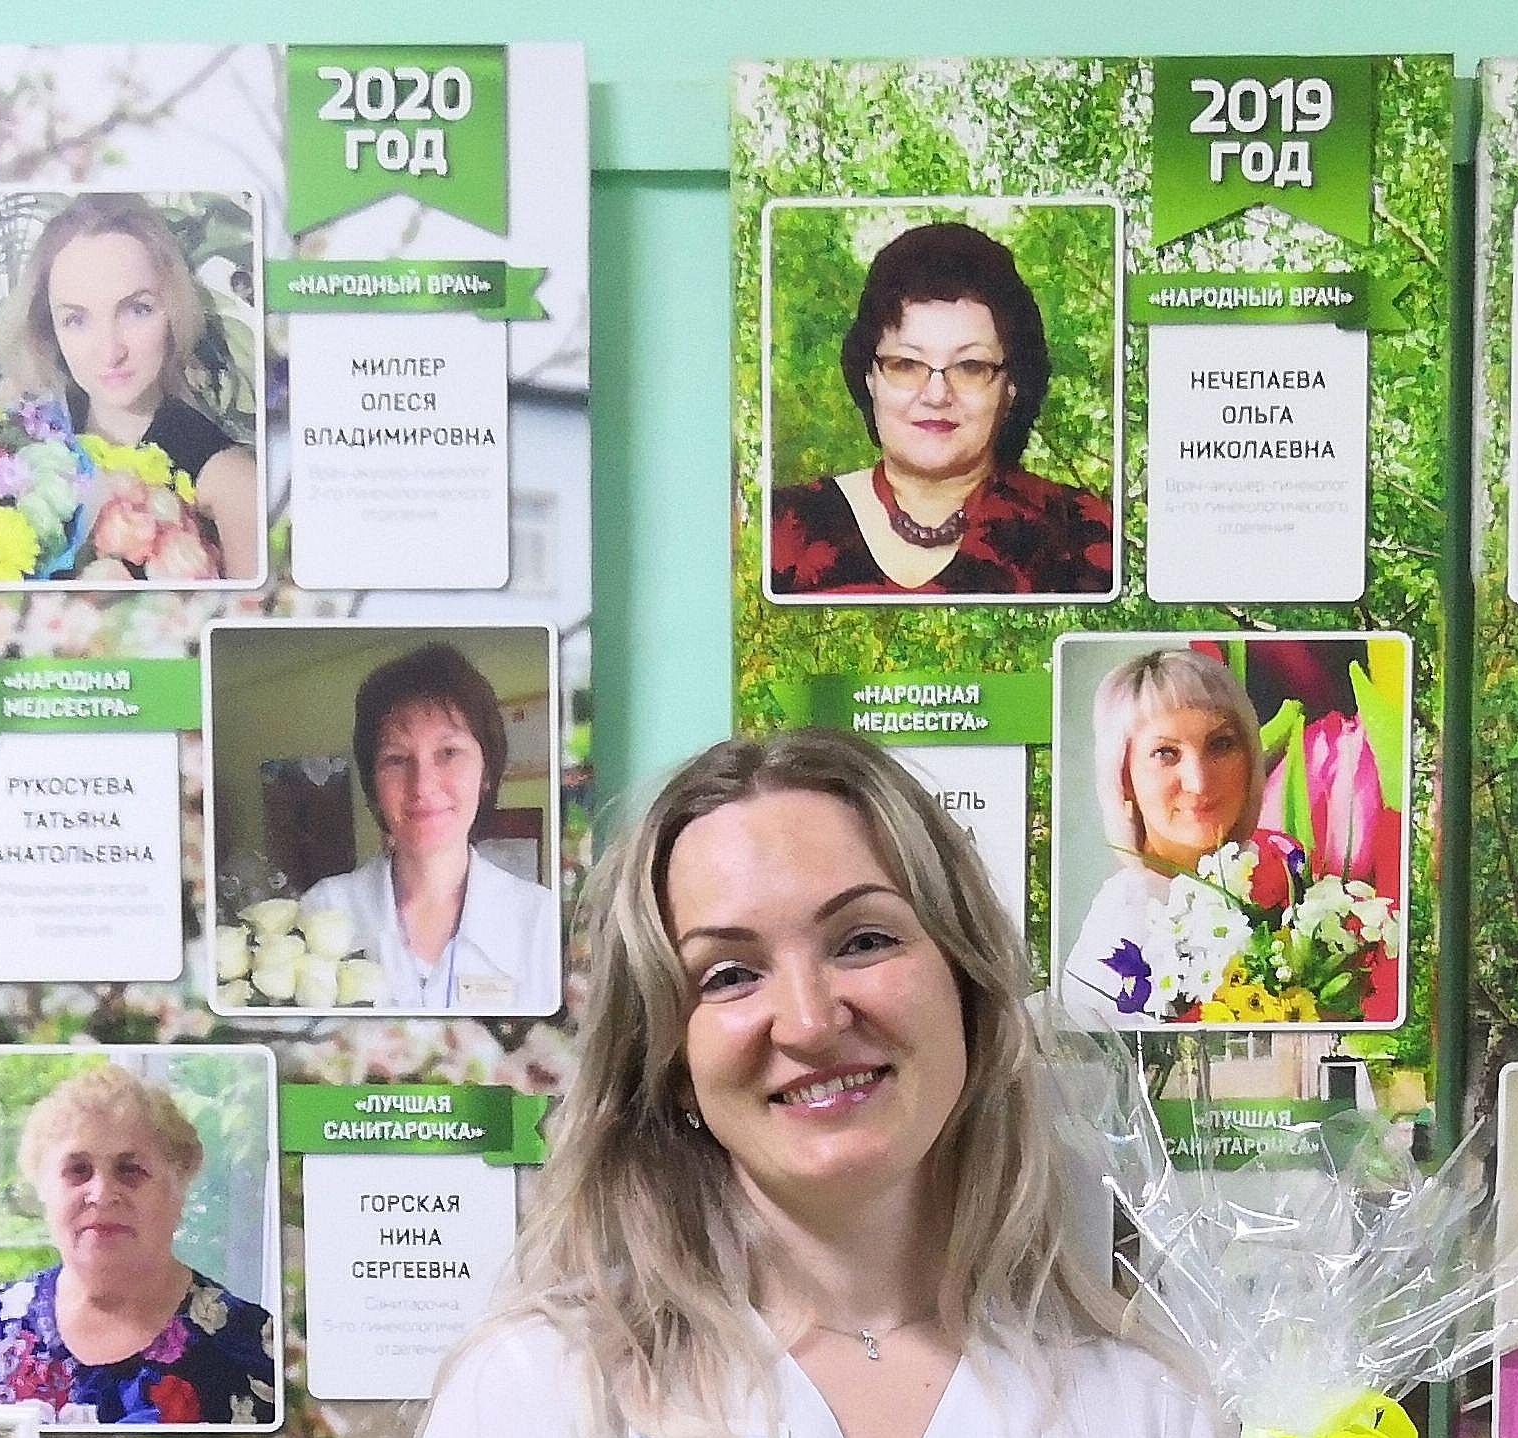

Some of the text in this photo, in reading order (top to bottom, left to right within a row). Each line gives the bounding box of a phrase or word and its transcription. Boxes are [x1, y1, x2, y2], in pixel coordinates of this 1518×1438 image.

[318, 66, 472, 121] 2020
[1190, 77, 1333, 135] 2019
[344, 127, 448, 176] ГОД
[1209, 141, 1313, 188] ГОД
[288, 269, 492, 297] «НАРОДНЫЙ ВРАЧ»
[1148, 281, 1354, 309] «НАРОДНЫЙ ВРАЧ»
[351, 358, 446, 378] МИЛЛЕР
[1191, 370, 1327, 391] НЕЧЕПАЕВА
[361, 392, 437, 412] ОЛЕСЯ
[1222, 405, 1294, 425] ОЛЬГА
[304, 427, 496, 448] ВЛАДИМИРОВНА
[1180, 440, 1336, 460] НИКОЛАЕВНА
[853, 684, 980, 706] «НАРОДНАЯ
[853, 711, 989, 732] МЕДСЕСТРА»
[8, 777, 135, 796] РУКОСУЕВА
[23, 811, 122, 830] ТАТЬЯНА
[354, 1094, 452, 1115] «ЛУЧШАЯ
[323, 1121, 487, 1142] САНИТАРОЧКА»
[360, 1194, 460, 1214] ГОРСКАЯ
[380, 1228, 443, 1247] НИНА
[352, 1261, 472, 1281] СЕРГЕЕВНА
